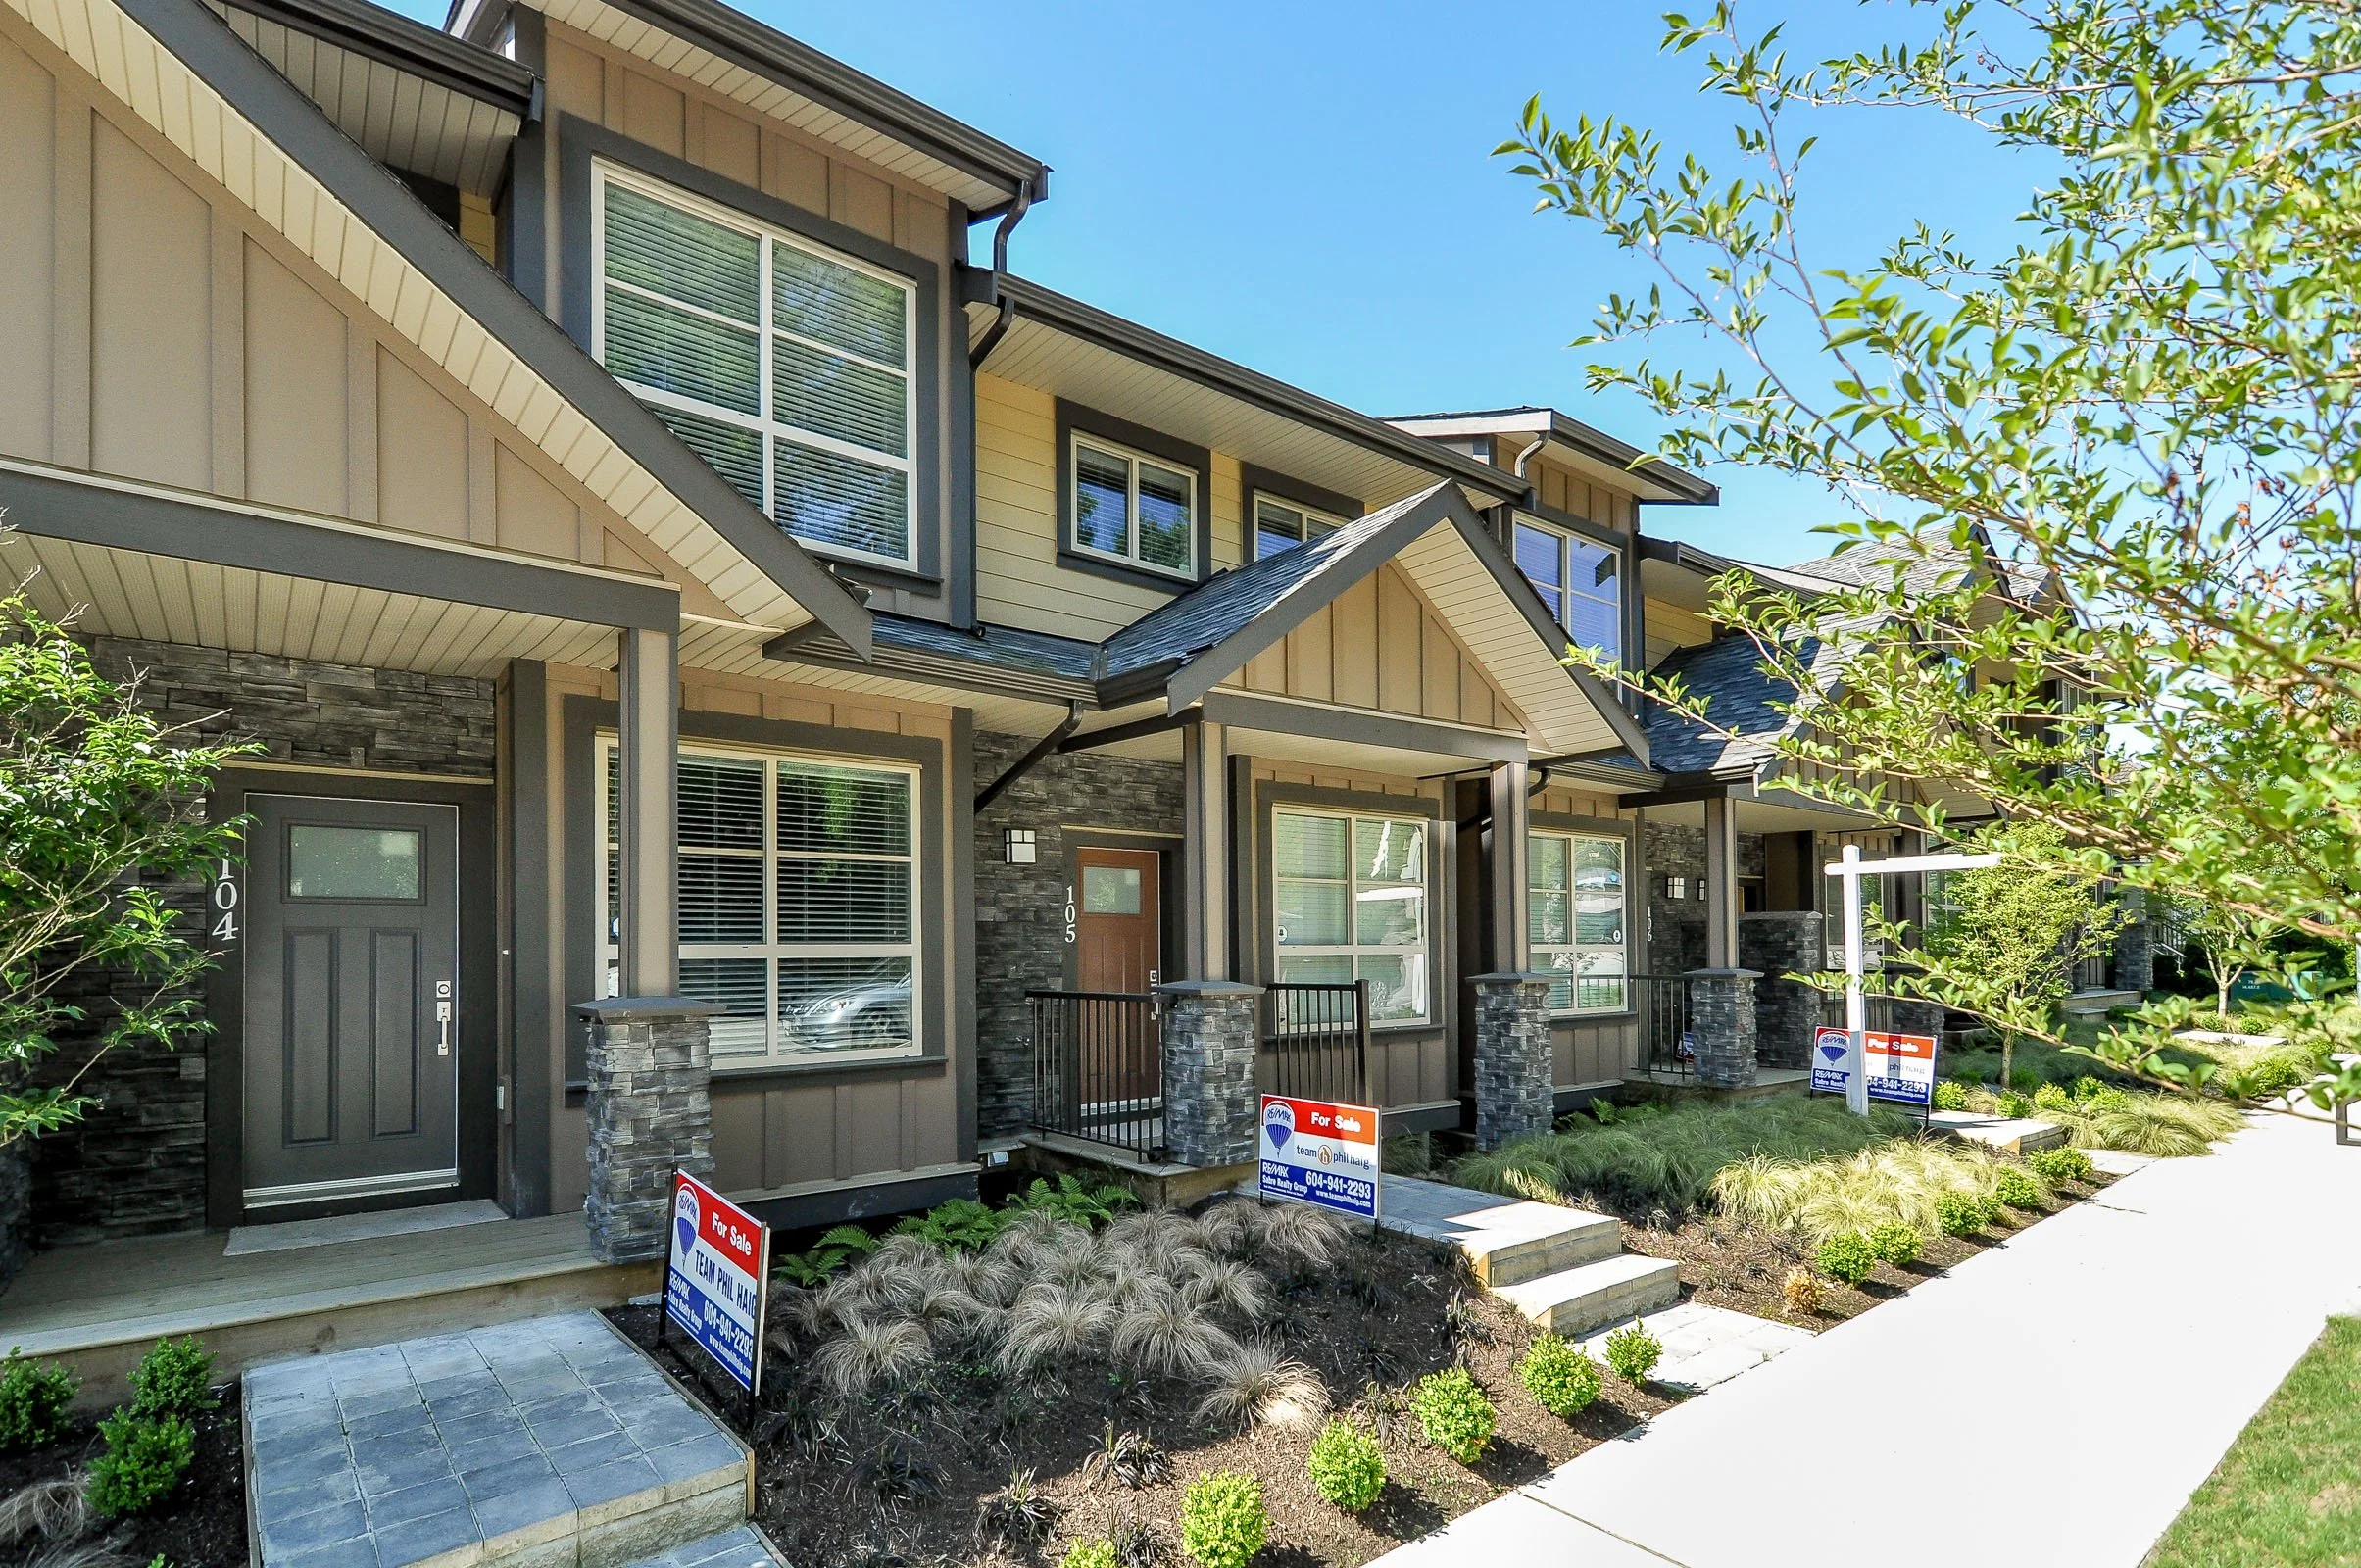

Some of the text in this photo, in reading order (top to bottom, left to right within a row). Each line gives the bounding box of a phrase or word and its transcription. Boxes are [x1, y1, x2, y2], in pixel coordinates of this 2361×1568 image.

[212, 852, 239, 941] 104
[1064, 885, 1076, 943] 105
[1892, 1040, 1919, 1053] Sale
[1815, 1070, 1843, 1081] RE/MAX
[1866, 1076, 1927, 1093] 04-941-2293
[1267, 1107, 1292, 1124] RE/MAX
[1310, 1111, 1361, 1133] For Sale
[1262, 1161, 1289, 1178] RE/MAX
[1297, 1145, 1370, 1170] team phil haig
[1277, 1177, 1293, 1191] Realty
[1305, 1170, 1371, 1200] 604-941-2293
[712, 1211, 752, 1256] For Sale
[669, 1270, 690, 1301] RE/MAX
[695, 1249, 716, 1287] TEAM
[716, 1266, 734, 1302] PHIL
[704, 1299, 753, 1362] 604-941-2293
